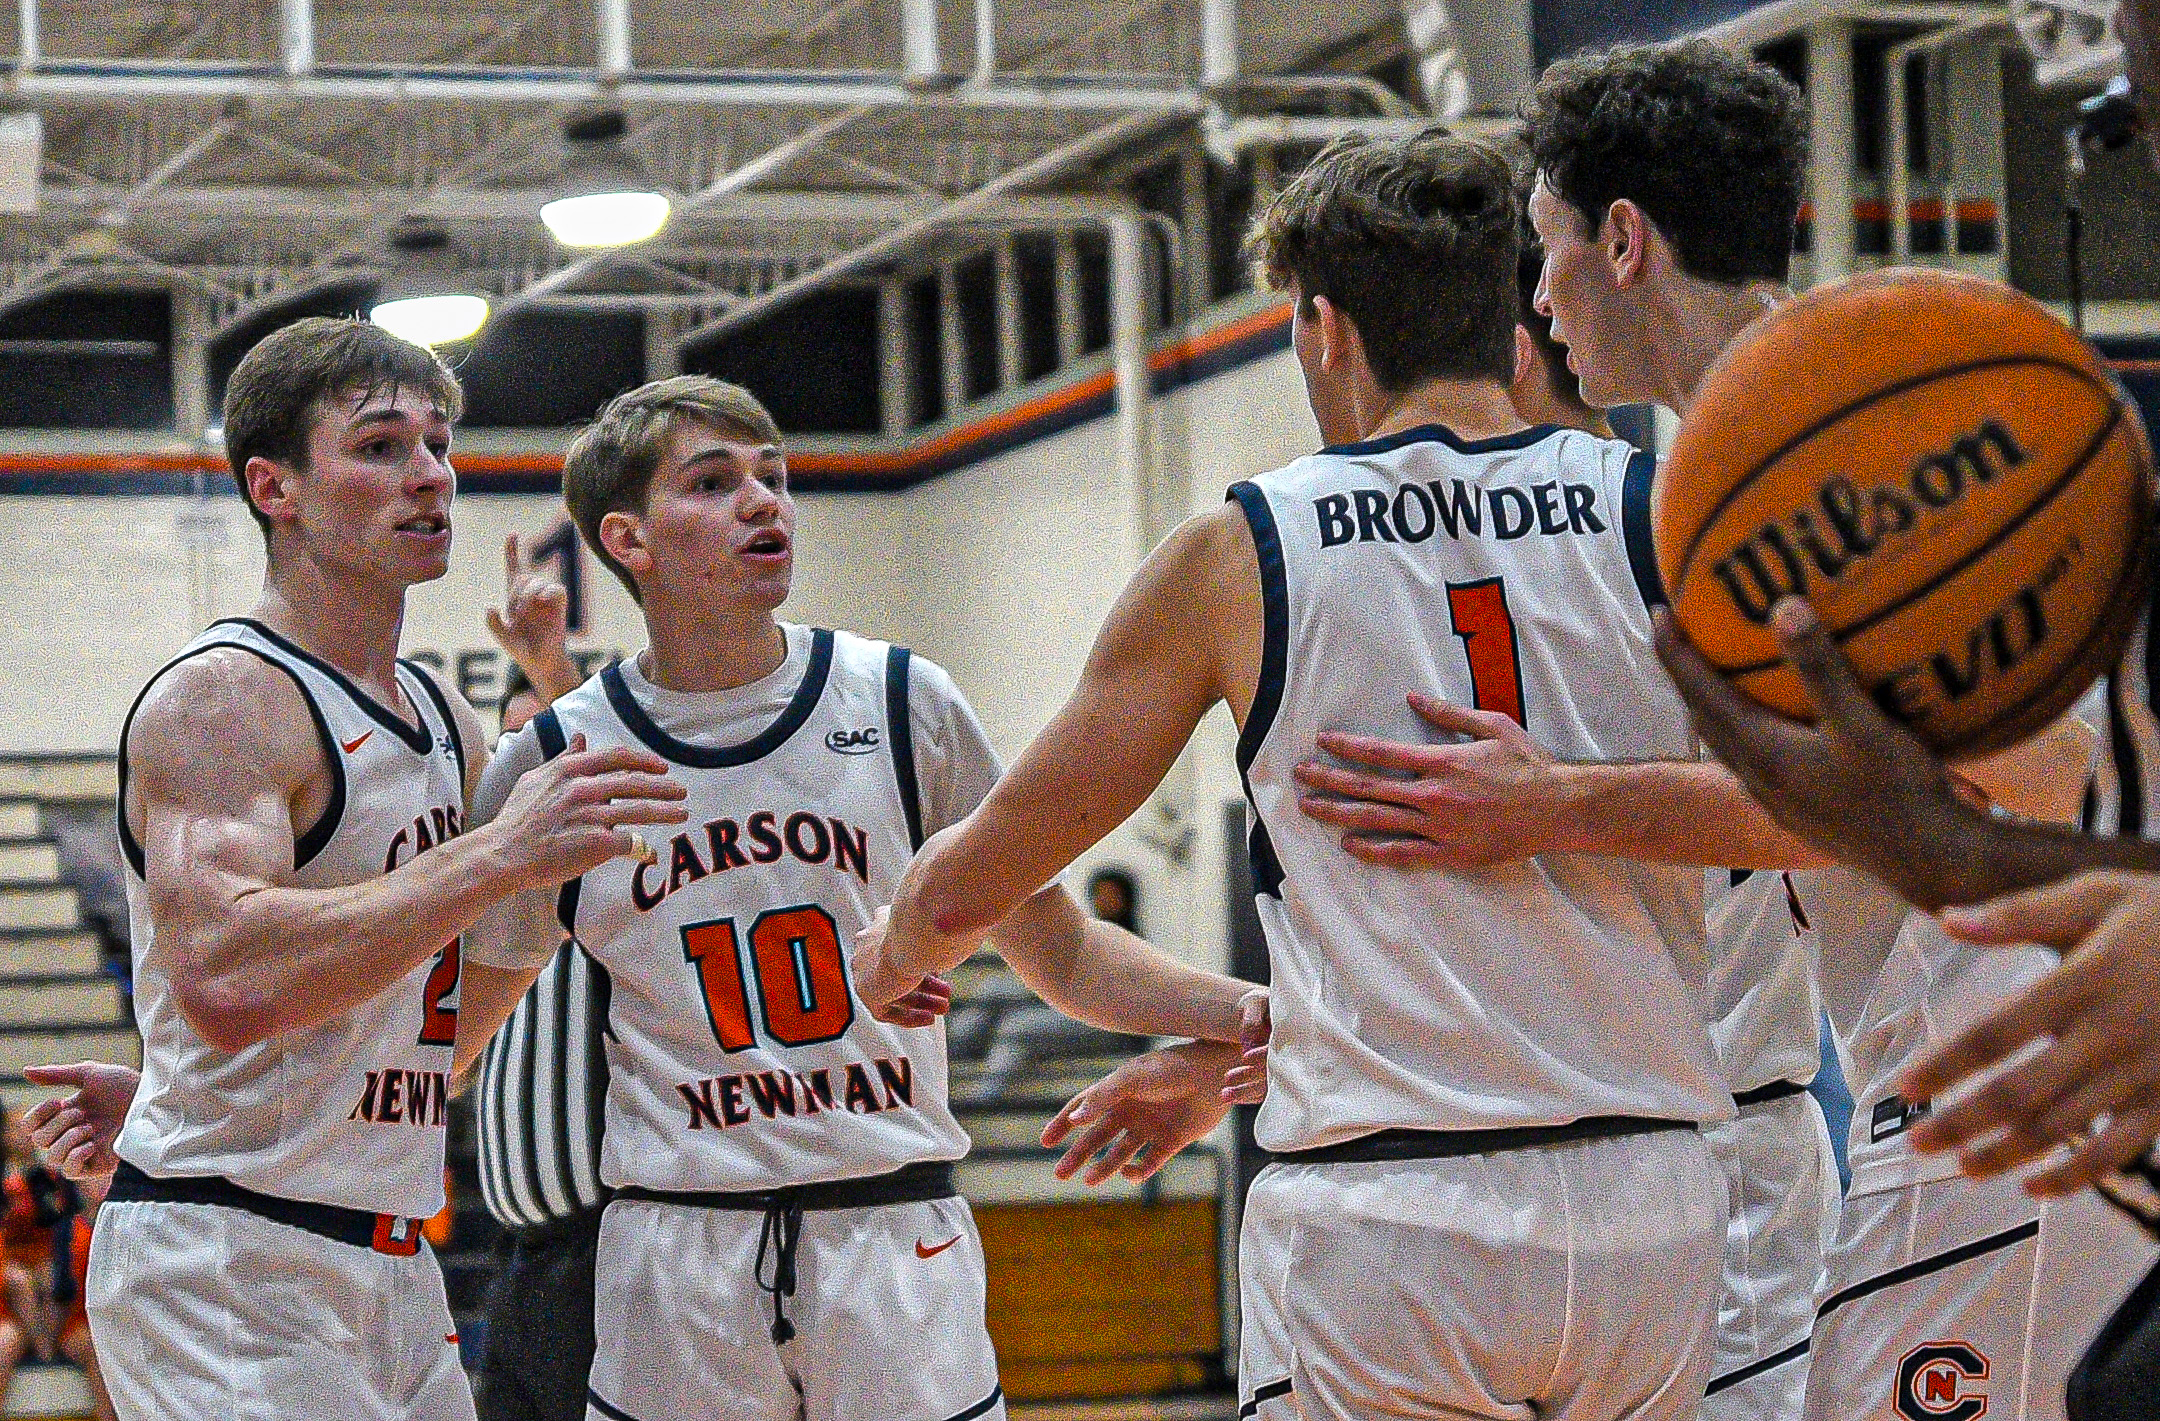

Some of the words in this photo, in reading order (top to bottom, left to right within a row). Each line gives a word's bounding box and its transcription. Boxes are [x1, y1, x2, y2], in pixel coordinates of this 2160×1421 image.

[1314, 478, 1607, 549] BROWDER
[1713, 419, 2030, 624] Wilson
[1445, 576, 1528, 732] 1
[831, 727, 880, 748] SAC
[384, 803, 464, 873] CARS
[631, 811, 869, 912] CARSON
[680, 903, 855, 1054] 10
[676, 1057, 914, 1130] NEWMAN
